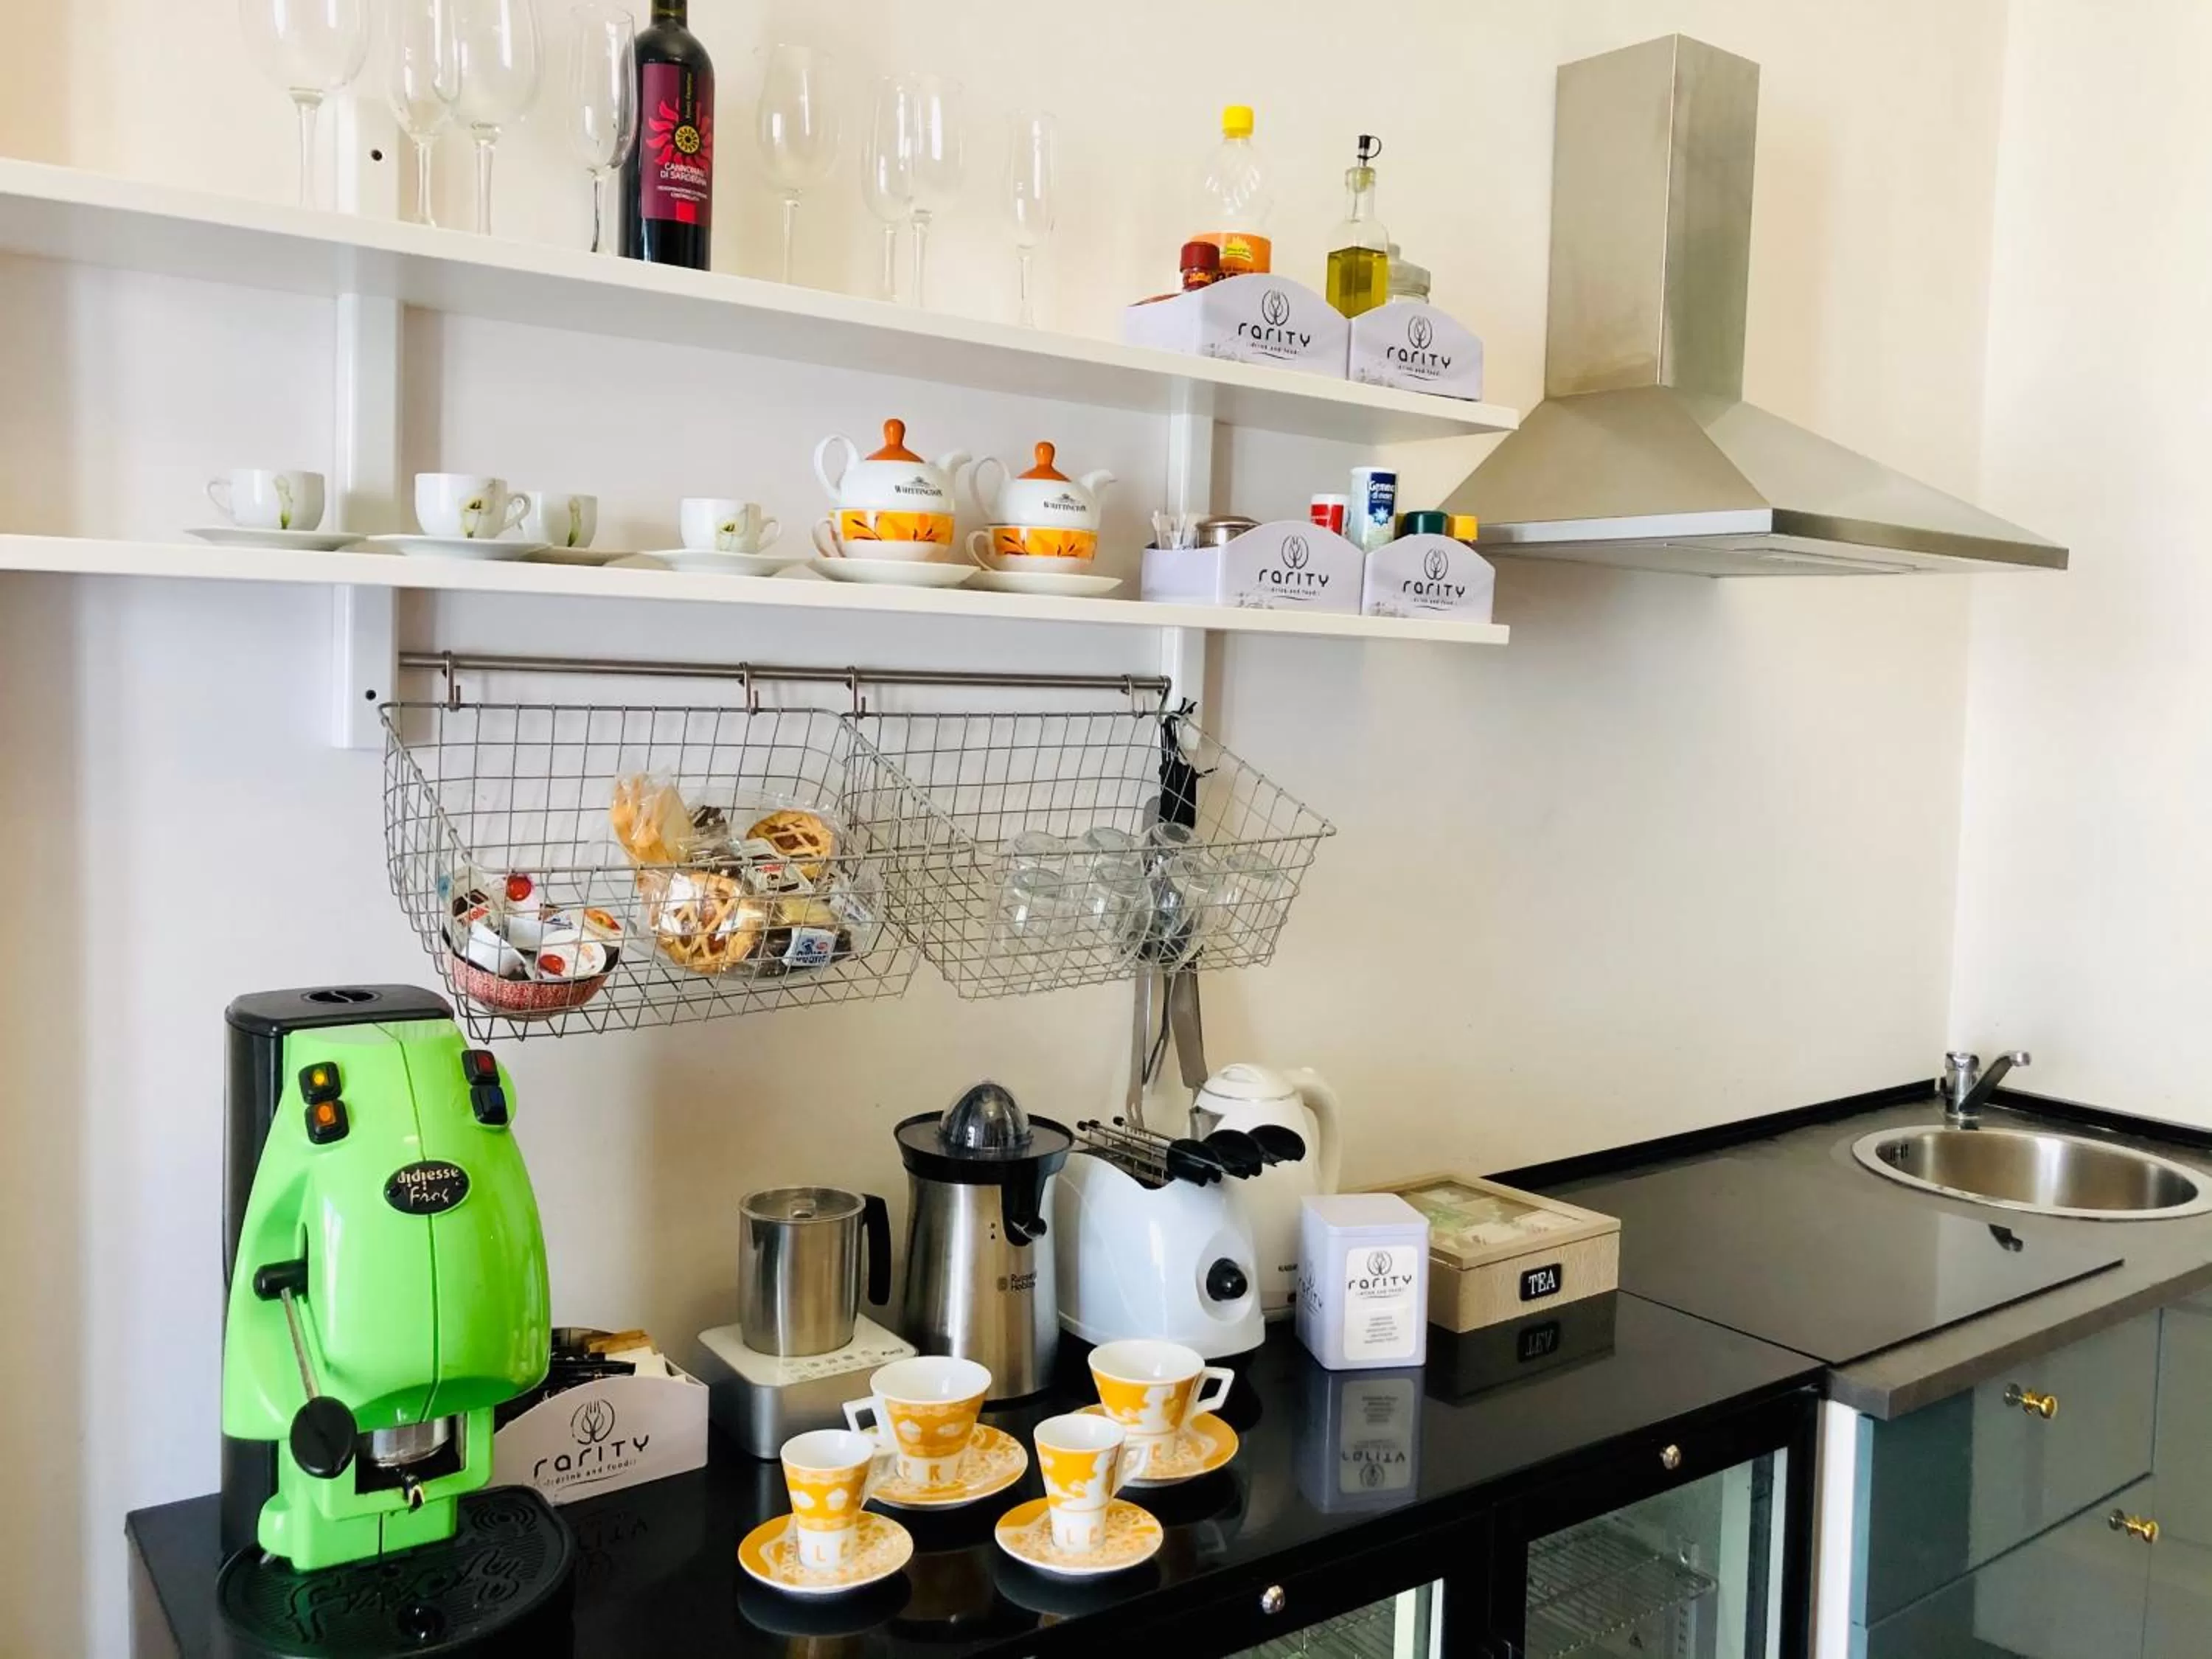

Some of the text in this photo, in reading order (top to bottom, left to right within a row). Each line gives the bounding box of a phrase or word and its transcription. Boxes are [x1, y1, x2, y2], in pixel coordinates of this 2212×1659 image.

[660, 170, 669, 179] DI
[1528, 1268, 1556, 1295] TEA
[586, 1467, 603, 1477] and
